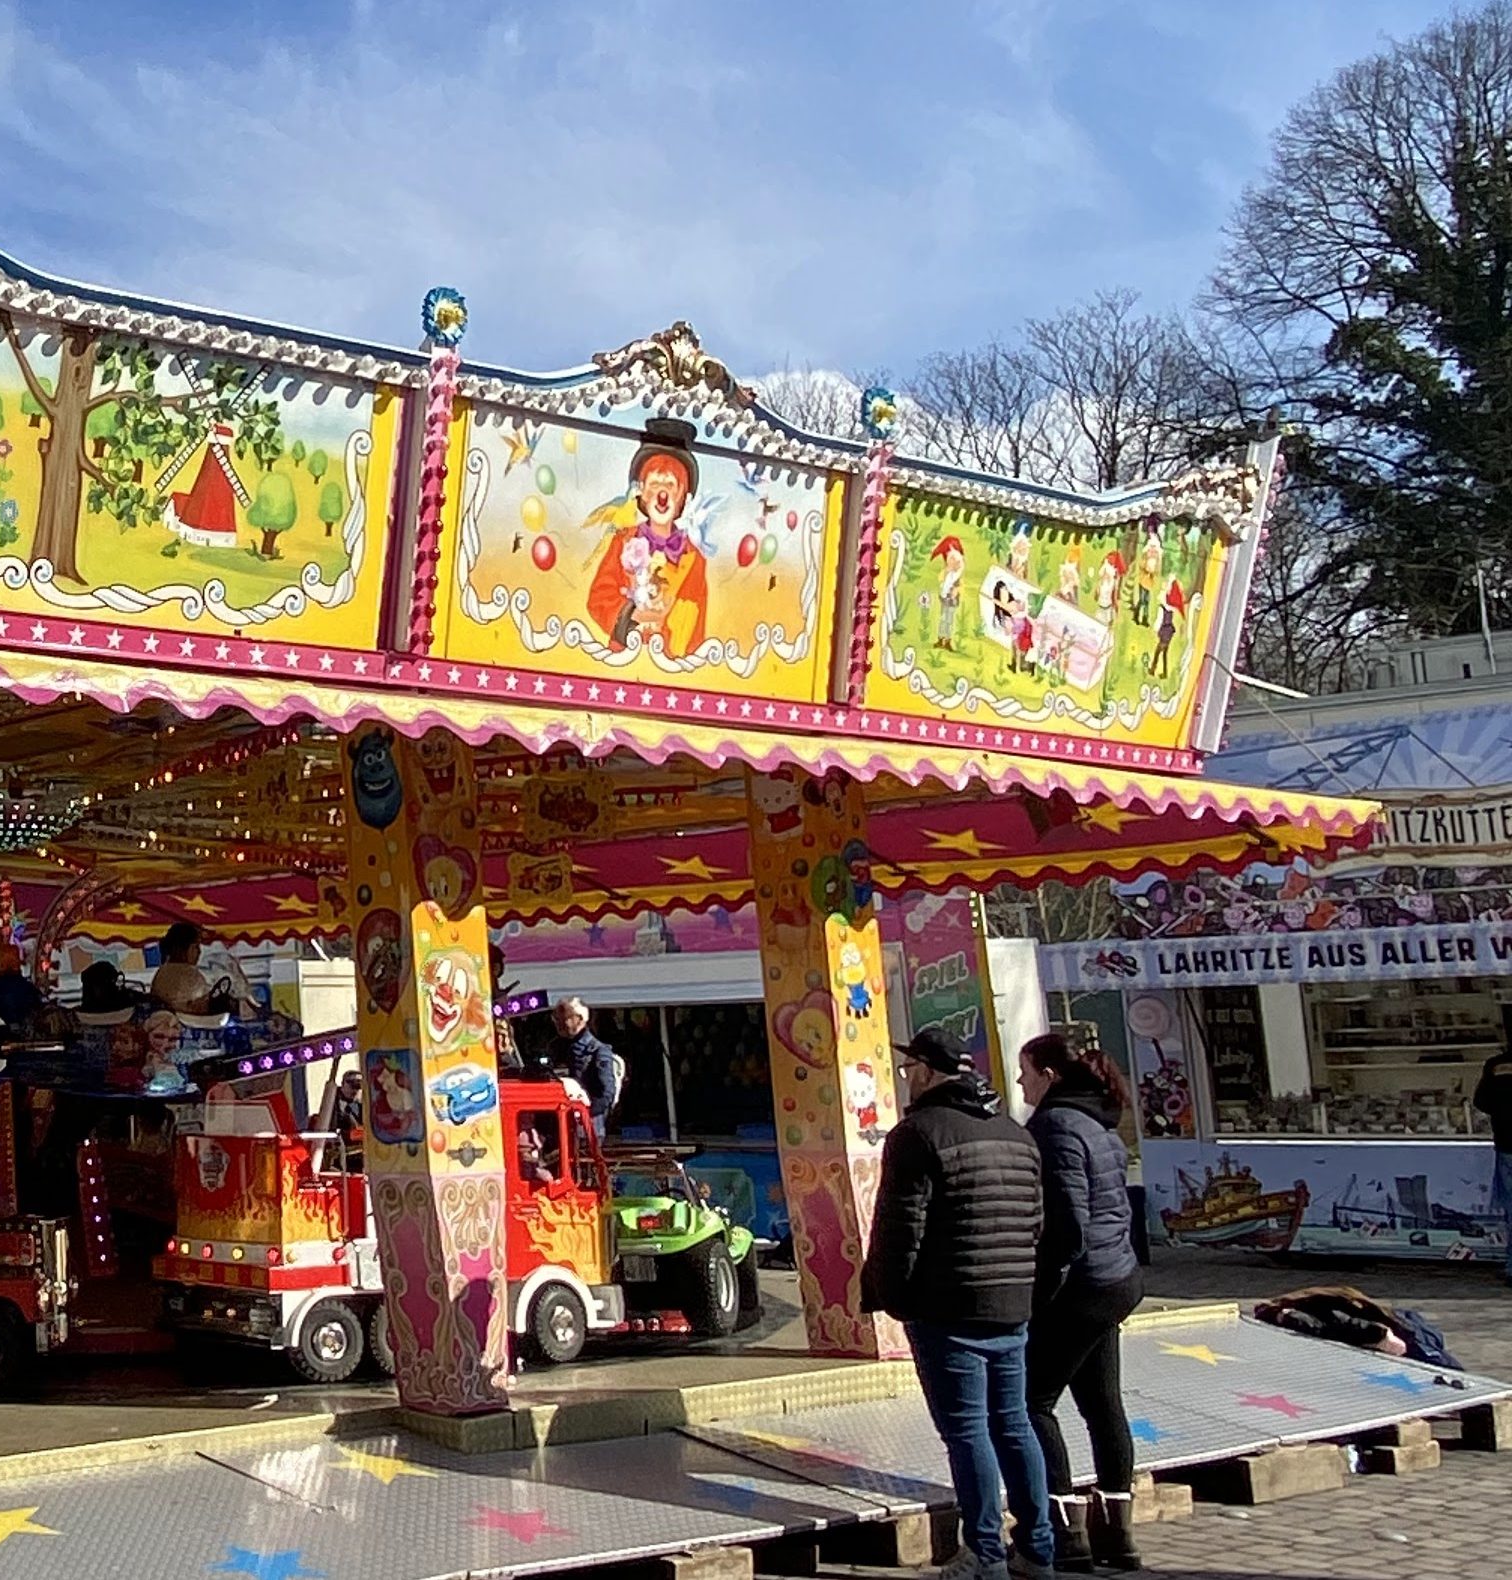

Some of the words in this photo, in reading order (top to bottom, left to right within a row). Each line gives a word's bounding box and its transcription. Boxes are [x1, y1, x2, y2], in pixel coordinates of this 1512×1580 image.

[1308, 943, 1366, 968] AUS
[1381, 938, 1476, 965] ALLER
[914, 952, 969, 998] SPIEL
